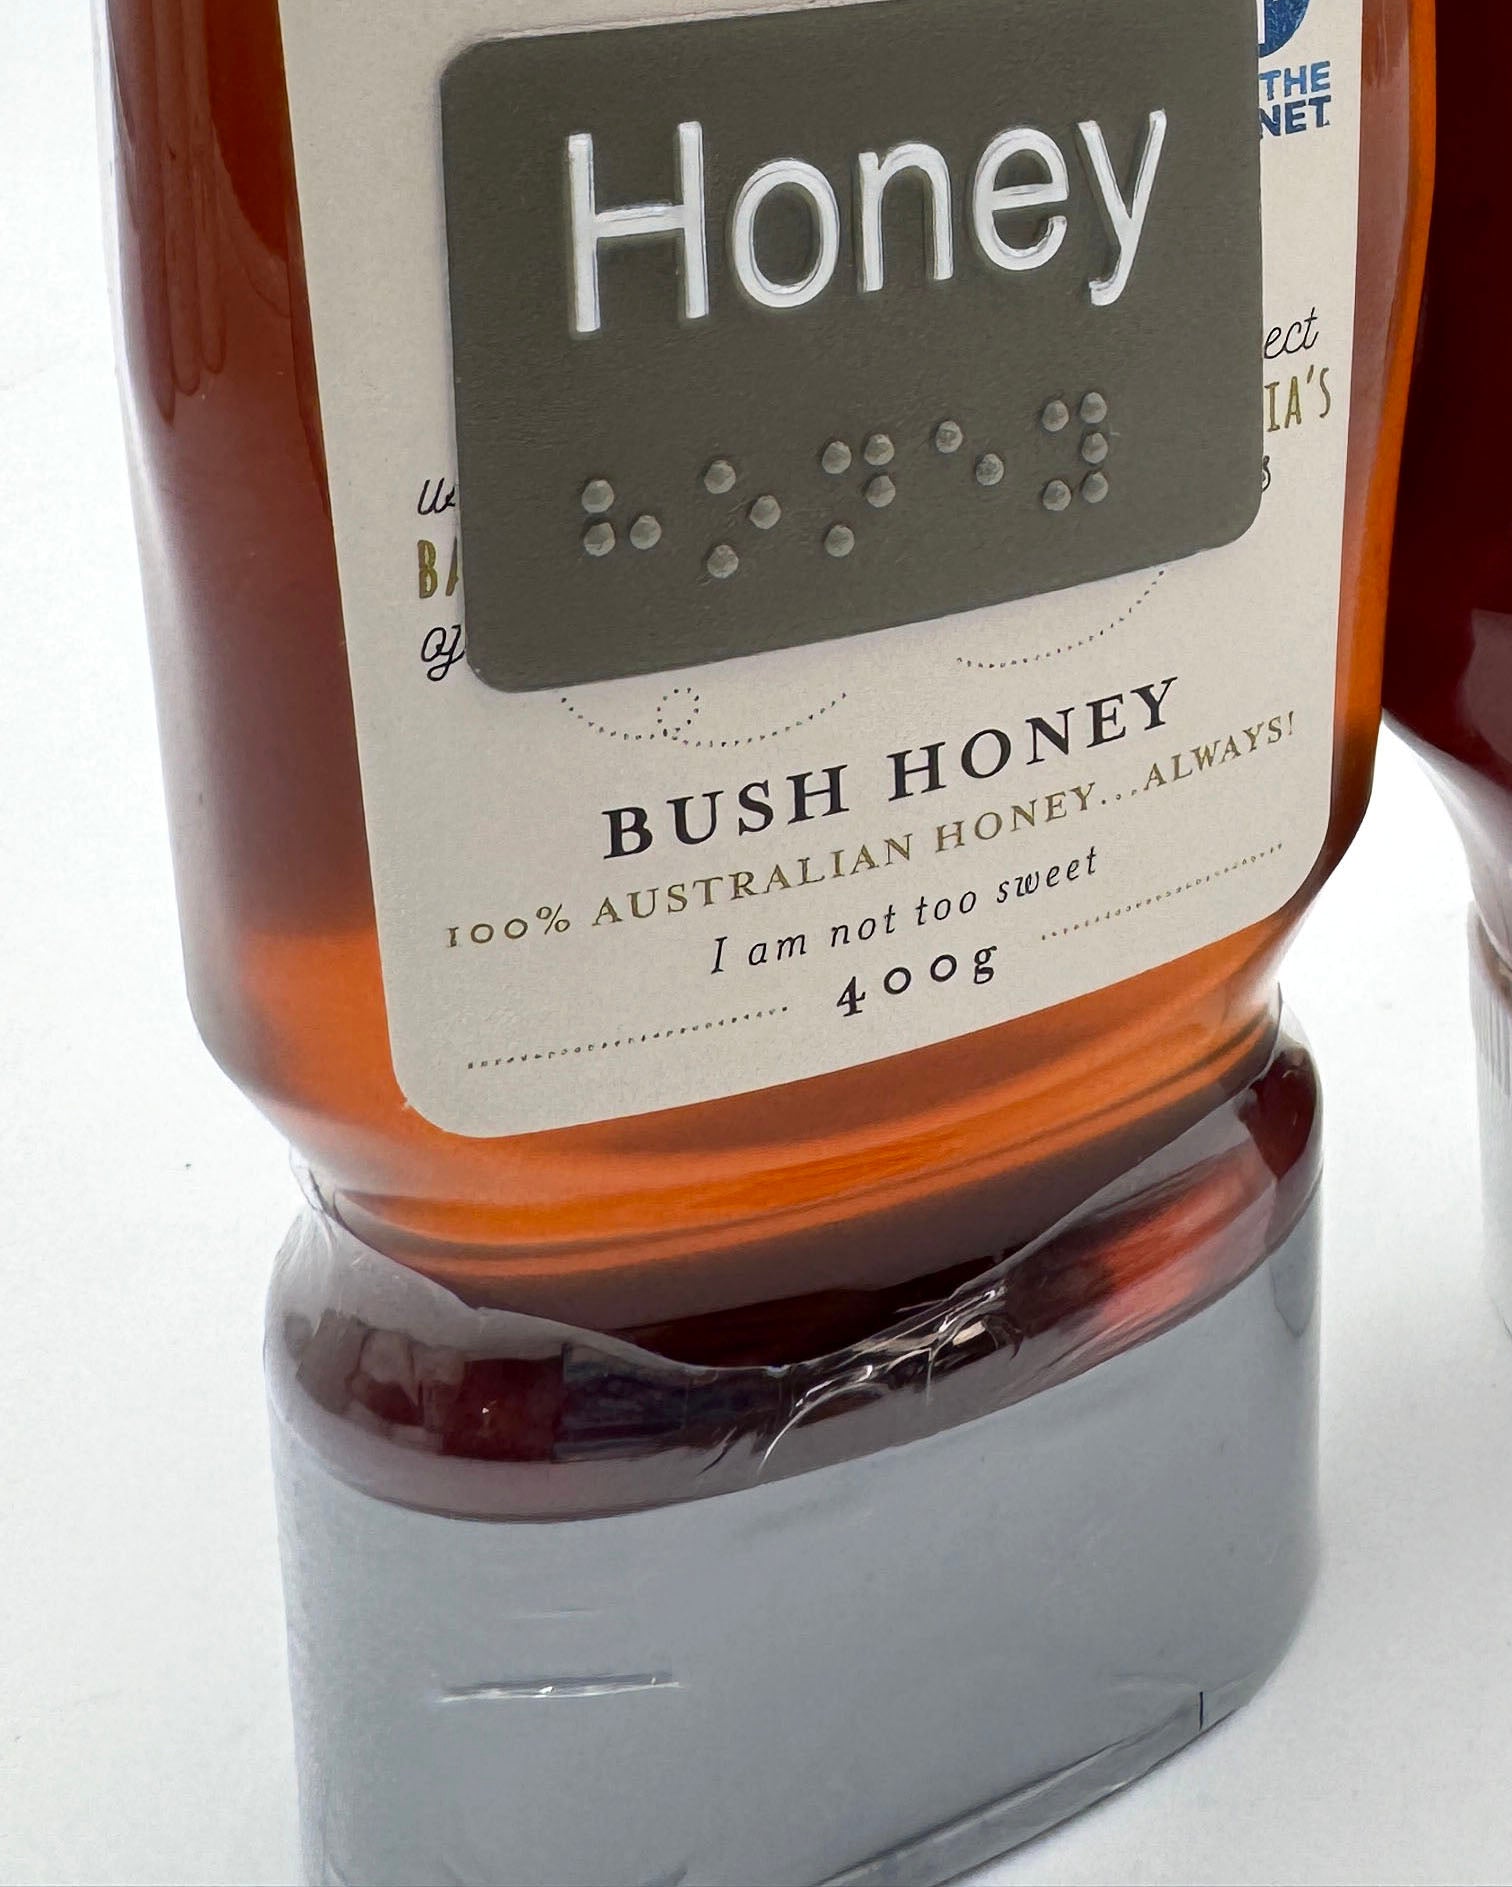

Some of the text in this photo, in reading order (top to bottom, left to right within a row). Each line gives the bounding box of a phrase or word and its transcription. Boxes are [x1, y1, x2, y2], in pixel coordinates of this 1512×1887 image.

[1258, 95, 1331, 140] NET
[1259, 60, 1331, 101] THE
[562, 108, 1167, 335] Honey
[602, 675, 1180, 861] BUSH HONEY
[446, 901, 572, 948] 100%
[590, 833, 913, 928] AUSTRALIAN
[709, 848, 1099, 974] I am not too sweet
[836, 943, 998, 1019] 400g
